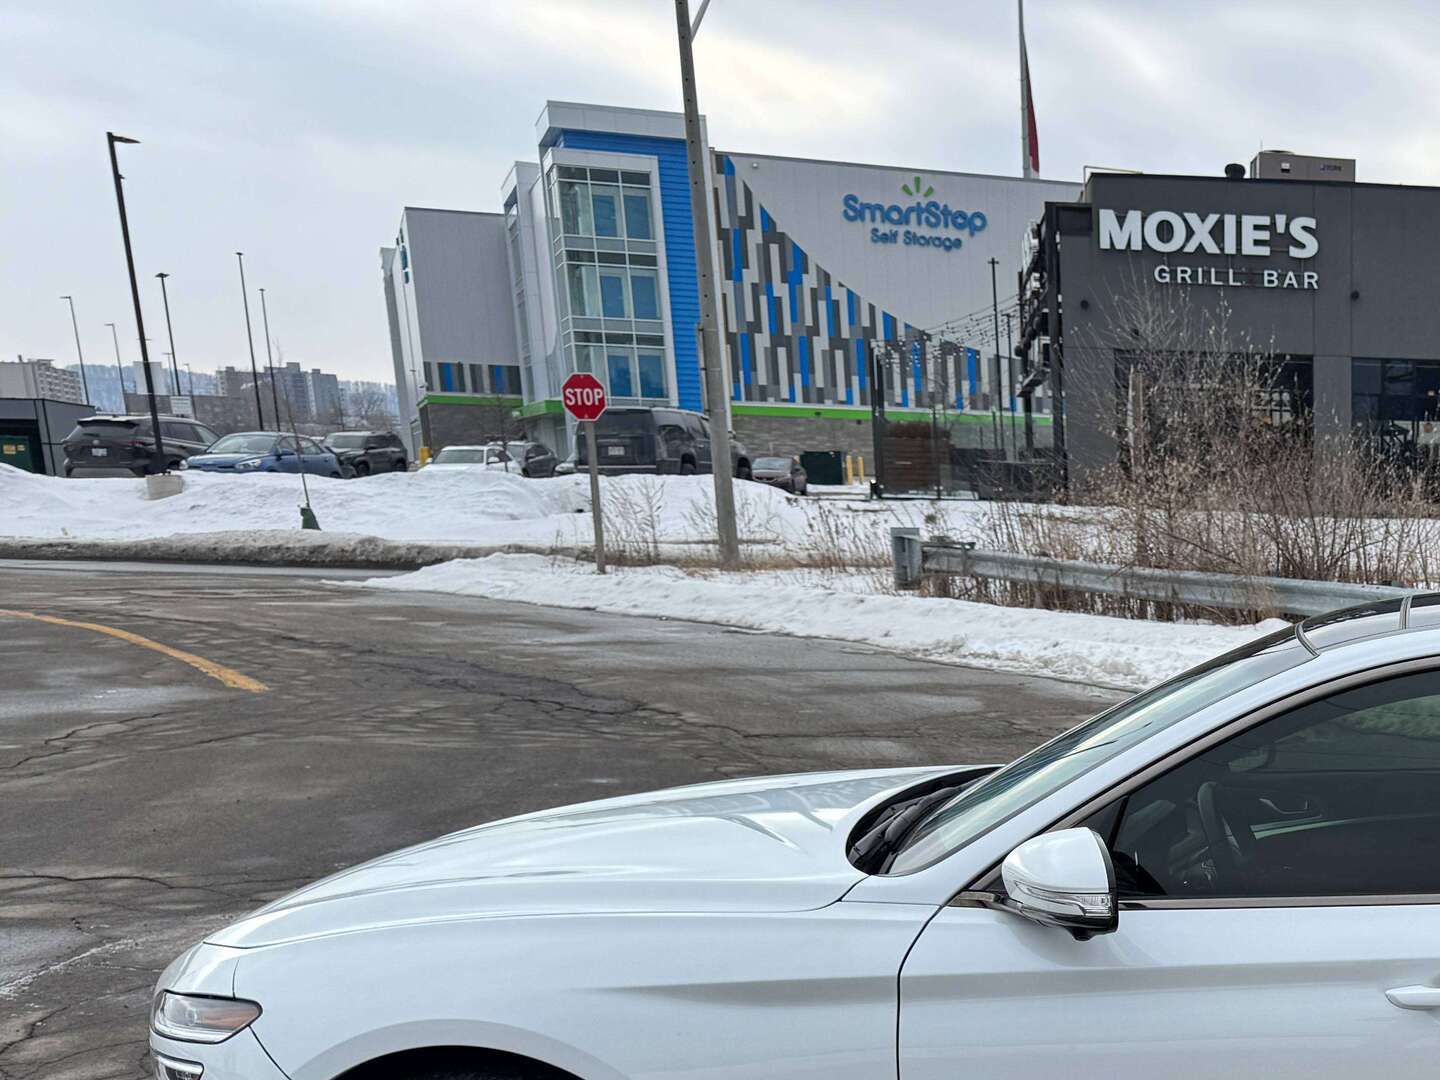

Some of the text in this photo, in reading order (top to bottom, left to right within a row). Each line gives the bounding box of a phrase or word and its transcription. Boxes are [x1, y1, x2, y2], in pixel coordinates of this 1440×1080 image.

[843, 194, 988, 238] SmartStop
[870, 227, 963, 252] Self Storage
[1099, 208, 1319, 259] MOXIE'S
[1154, 264, 1319, 290] GRILL BAR
[565, 387, 603, 406] STOP
